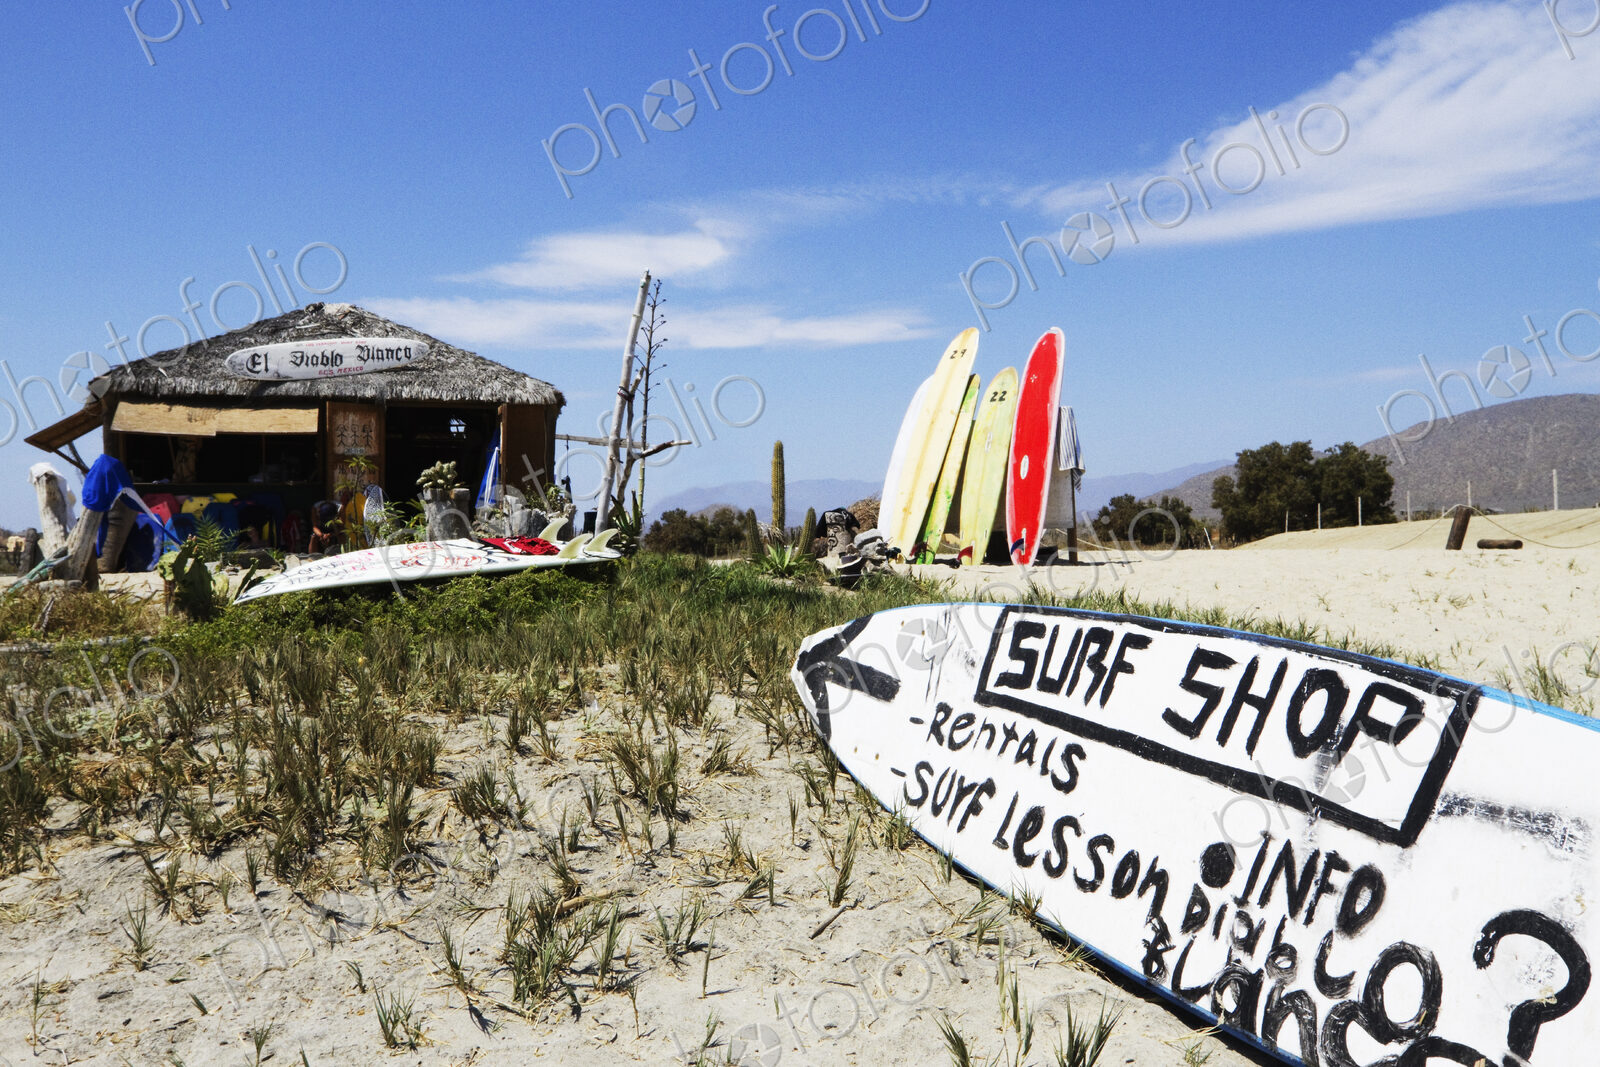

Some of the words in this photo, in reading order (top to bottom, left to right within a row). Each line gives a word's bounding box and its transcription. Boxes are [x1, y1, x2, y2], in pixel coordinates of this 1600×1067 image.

[245, 352, 270, 374] El
[289, 350, 344, 369] Diablo
[356, 344, 412, 363] Blanco
[990, 390, 1007, 402] 22
[994, 620, 1153, 709] SURF
[1161, 643, 1426, 764] SHOP
[1231, 831, 1387, 939] INFO
